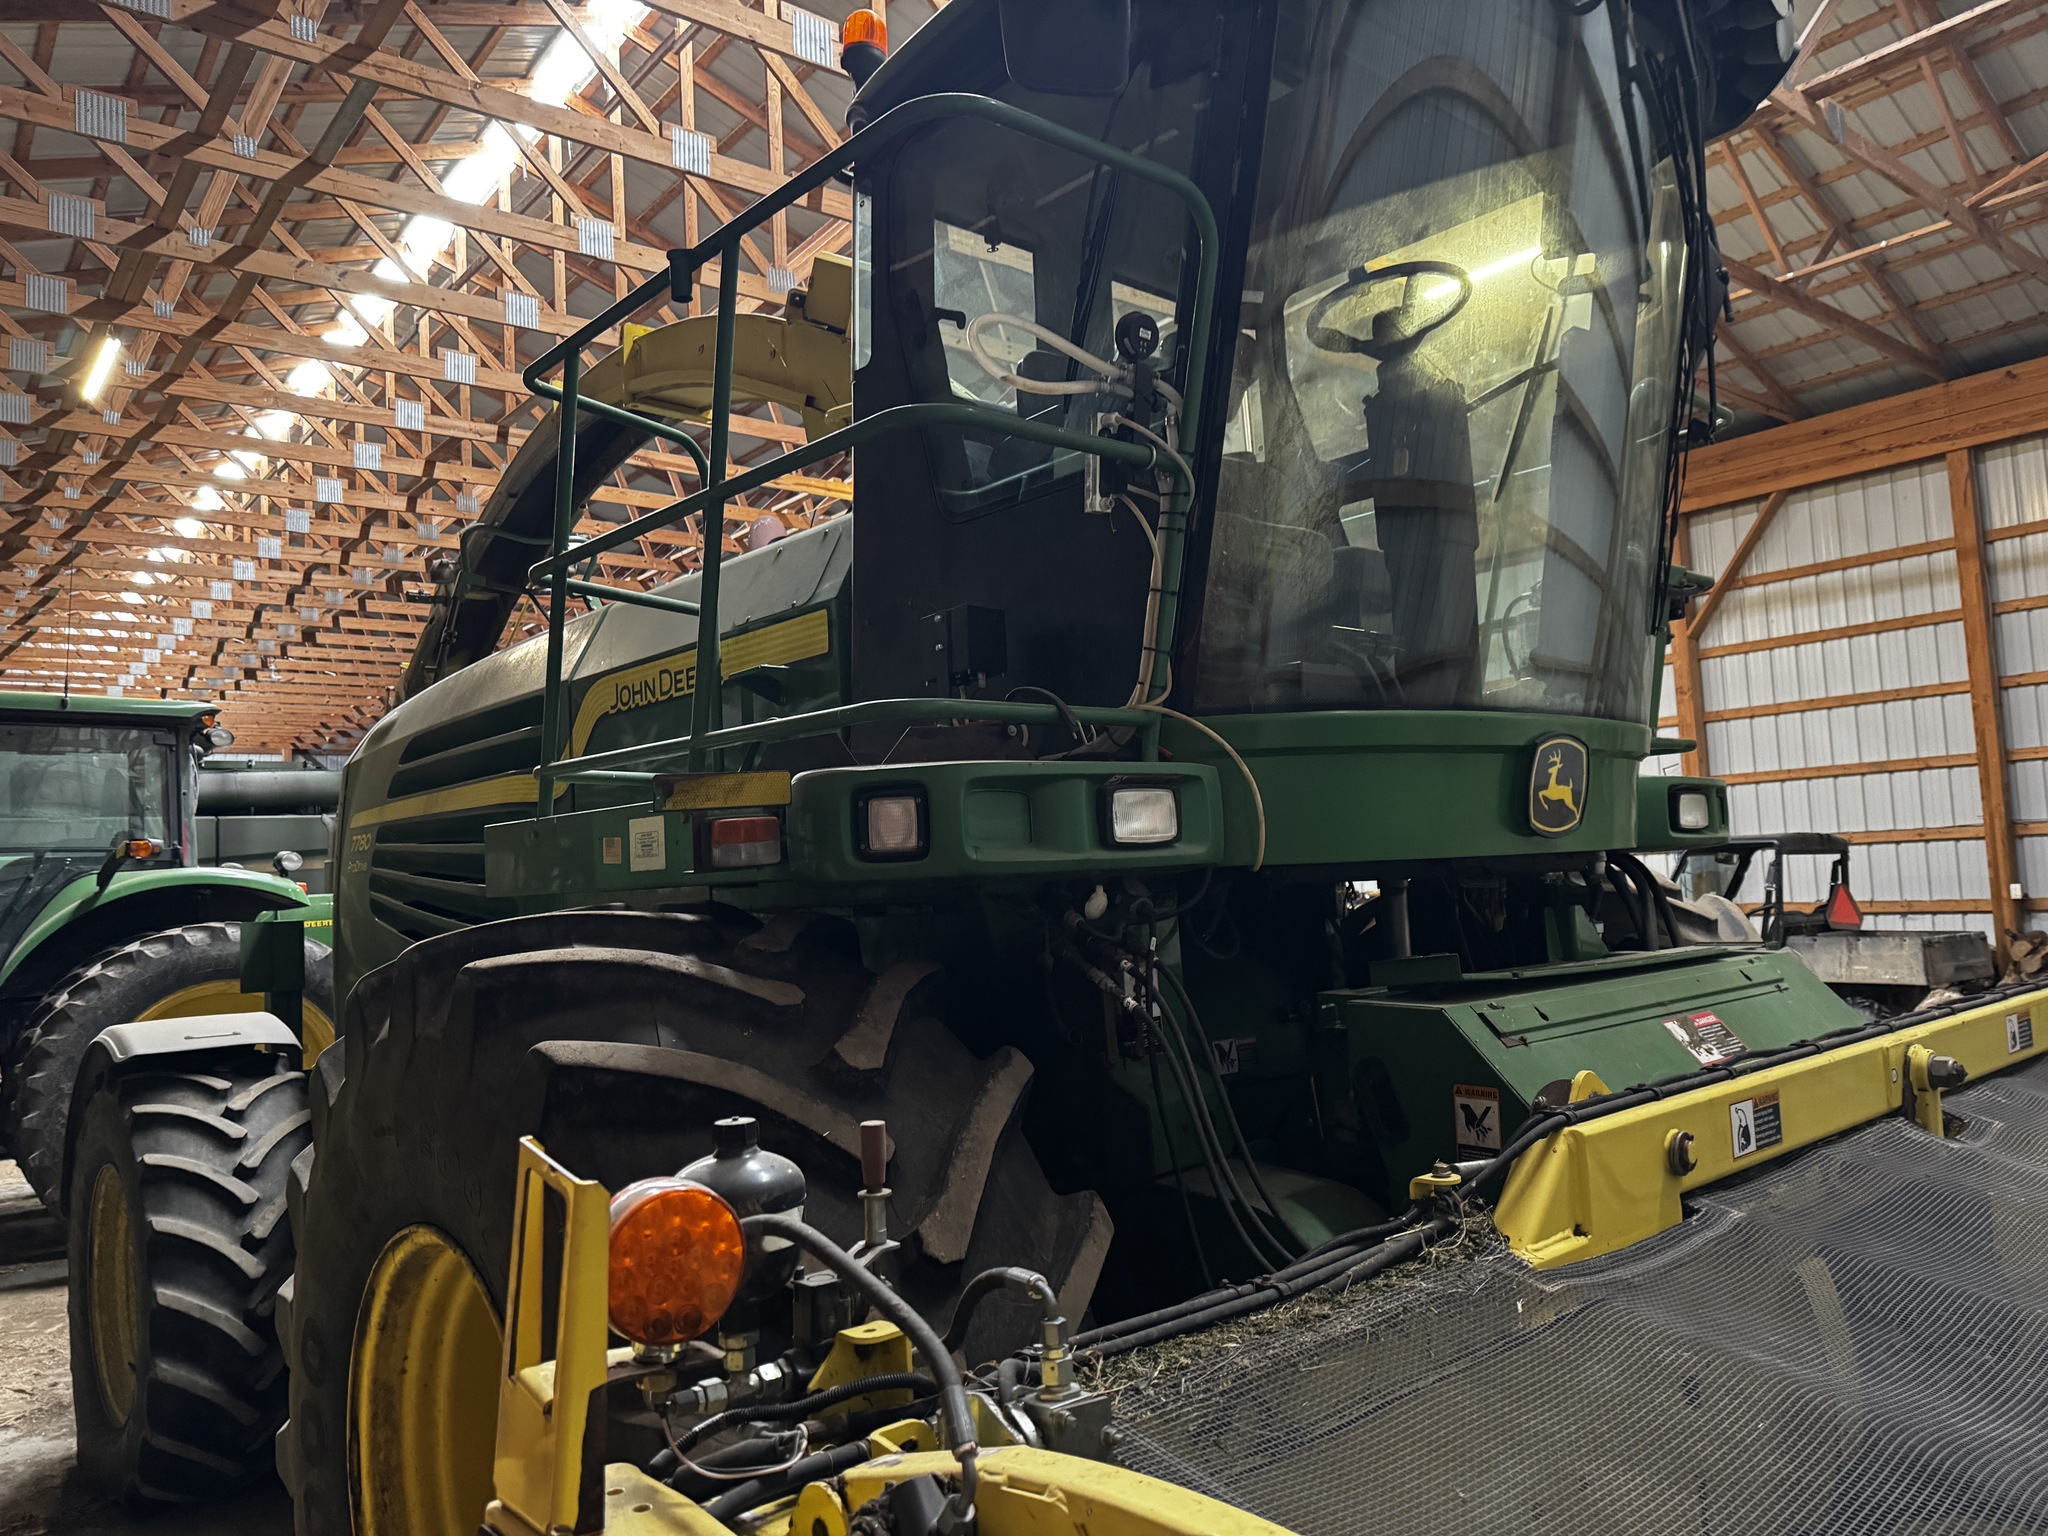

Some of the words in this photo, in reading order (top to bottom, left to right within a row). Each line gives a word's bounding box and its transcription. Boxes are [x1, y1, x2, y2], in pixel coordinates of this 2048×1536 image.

[610, 679, 656, 710] JOHN
[659, 666, 696, 697] DEE
[351, 833, 372, 852] 7780
[1697, 1015, 1718, 1025] DANGER
[1464, 1088, 1498, 1100] WARNING
